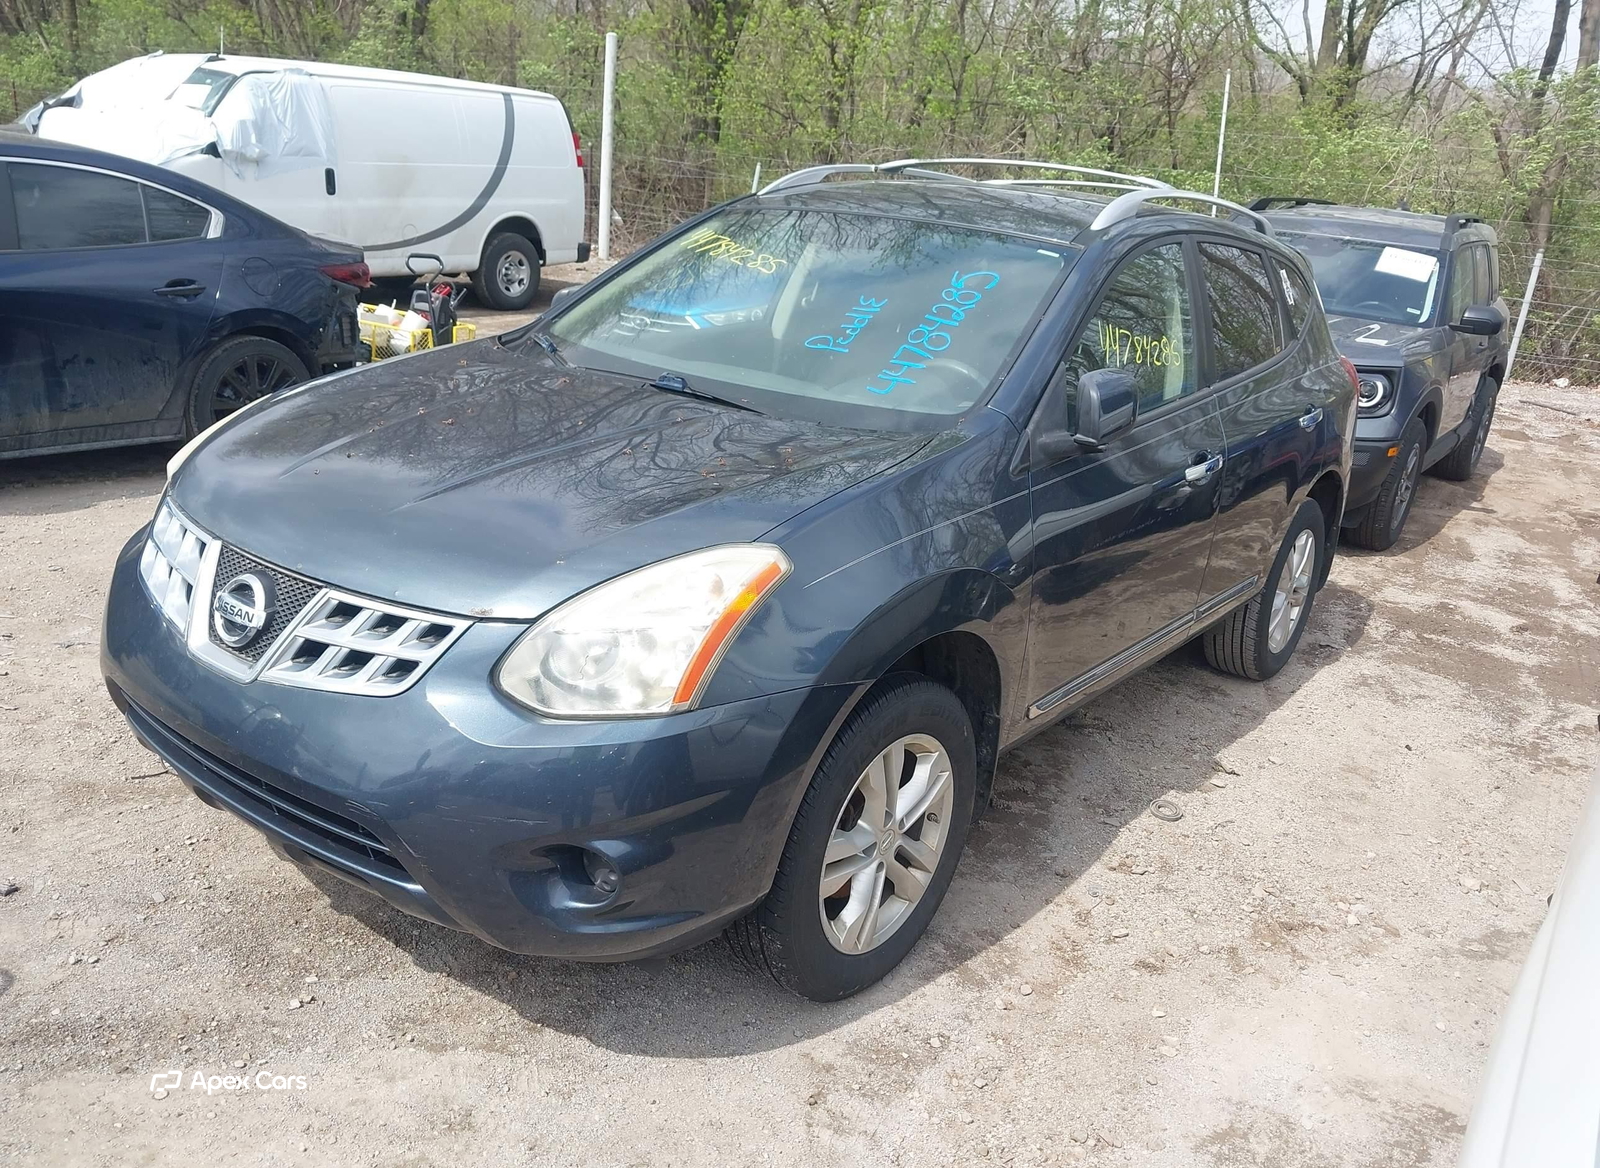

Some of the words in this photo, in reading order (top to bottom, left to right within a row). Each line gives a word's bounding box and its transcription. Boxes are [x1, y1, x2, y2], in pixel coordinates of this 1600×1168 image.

[681, 228, 787, 274] 44784285
[866, 270, 1000, 395] 44784285
[1098, 320, 1182, 368] 44784285
[1354, 323, 1389, 346] 2
[216, 596, 255, 623] NISSAN
